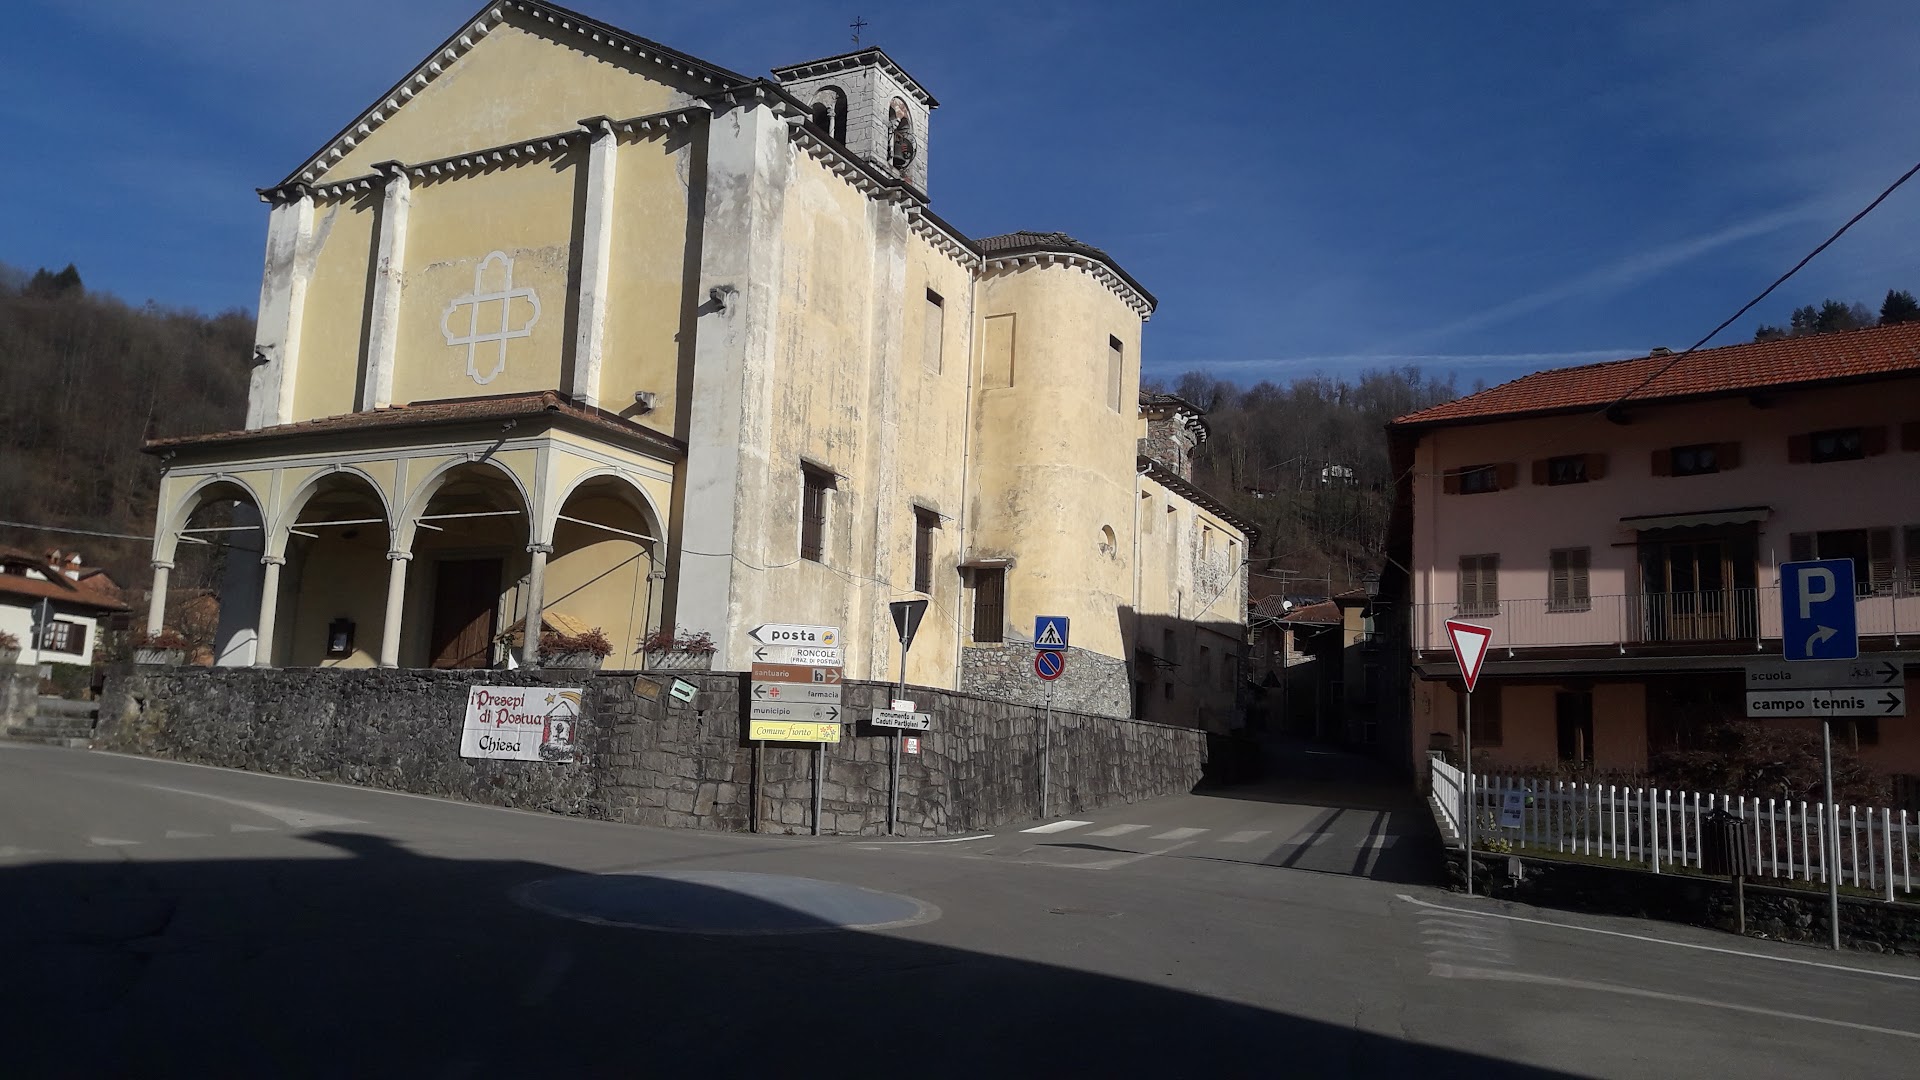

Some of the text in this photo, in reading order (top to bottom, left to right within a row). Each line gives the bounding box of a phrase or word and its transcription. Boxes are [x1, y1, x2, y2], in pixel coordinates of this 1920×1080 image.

[1798, 567, 1836, 619] P
[772, 630, 816, 641] posta
[797, 649, 836, 658] RONCOLE
[754, 670, 790, 678] santuario
[1751, 671, 1792, 681] scuola
[807, 690, 839, 698] farmacia
[471, 690, 525, 710] i Presepi
[1752, 697, 1865, 711] campo tennis
[753, 707, 791, 716] municipio
[880, 712, 910, 720] monumento
[480, 708, 542, 728] di Postua
[875, 717, 919, 728] Caduti Partigiani
[756, 724, 812, 739] Comune fiorito
[479, 735, 521, 754] Chiesa
